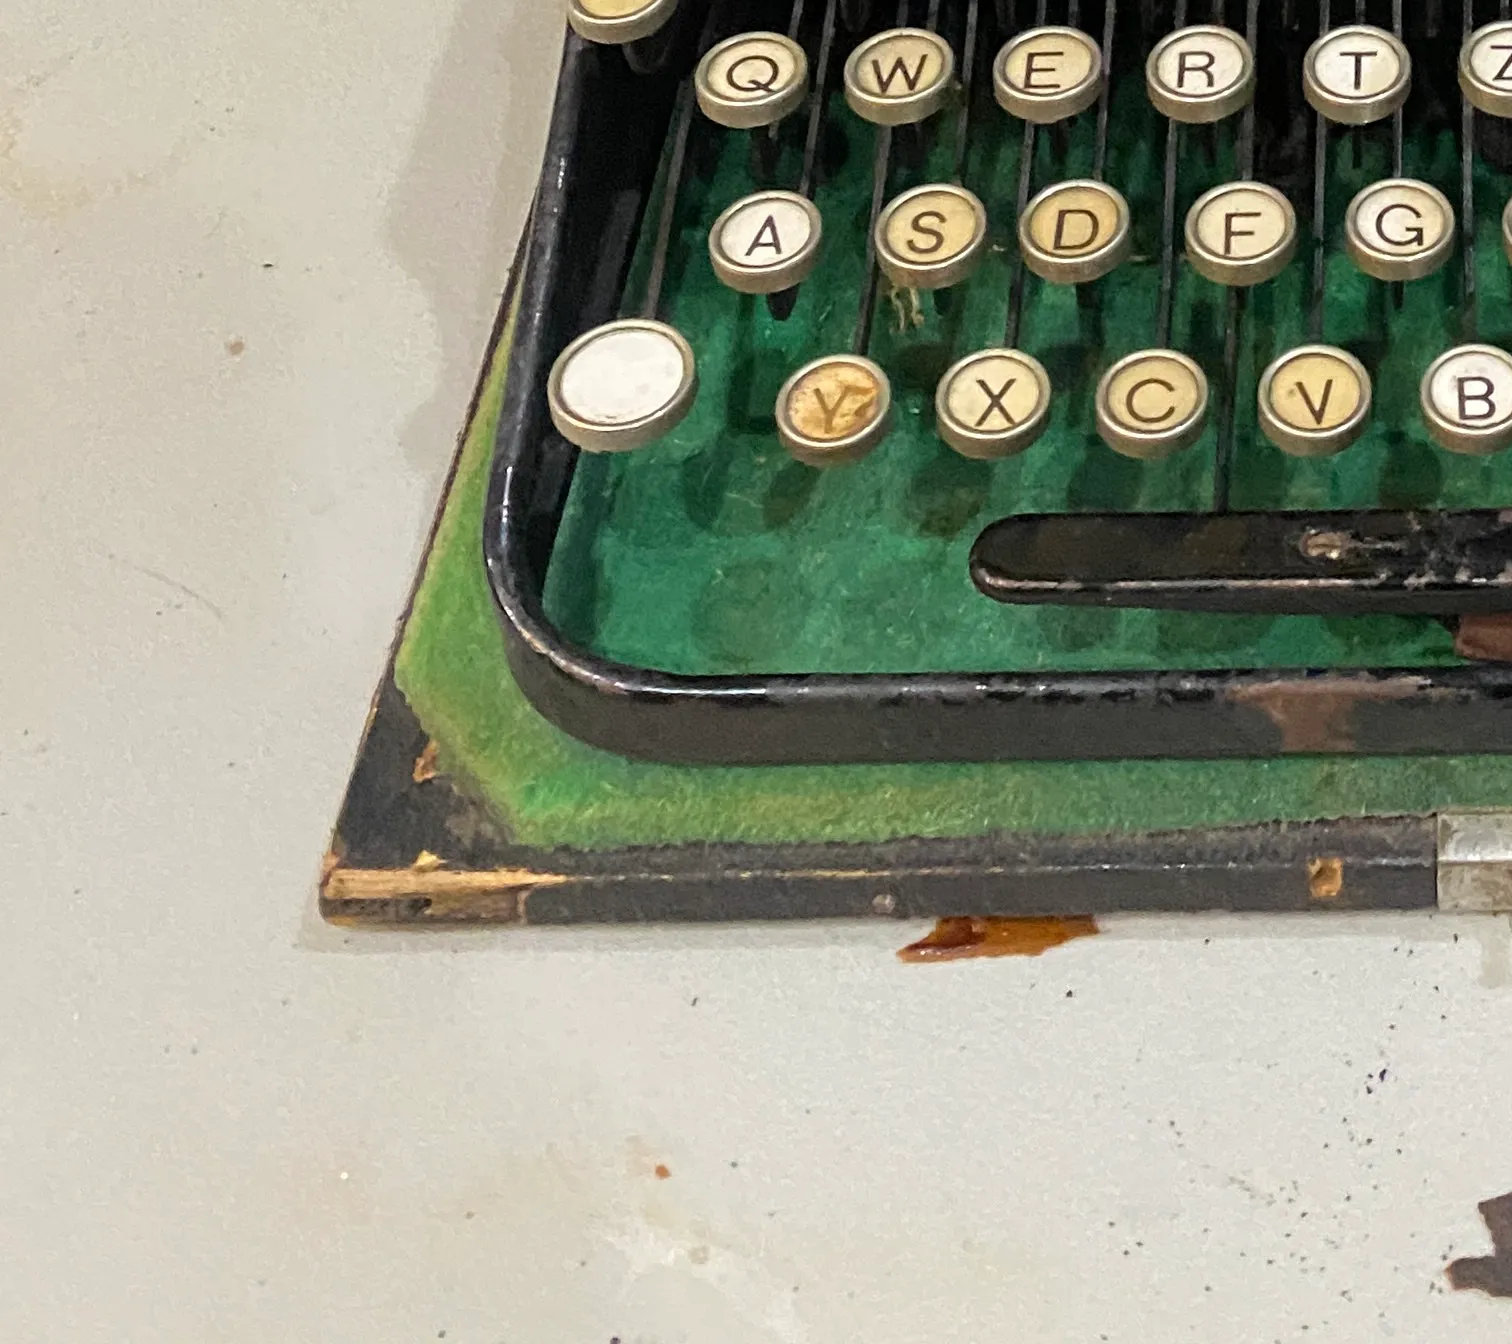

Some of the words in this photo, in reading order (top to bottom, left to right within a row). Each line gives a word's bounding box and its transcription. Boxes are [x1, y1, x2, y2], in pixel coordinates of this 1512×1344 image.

[726, 54, 780, 94] Q
[871, 53, 928, 93] W
[1023, 51, 1064, 90] E
[1176, 51, 1216, 88] R
[1340, 51, 1378, 91] T
[744, 214, 783, 257] A
[905, 210, 946, 255] S
[1053, 209, 1100, 251] D
[1223, 211, 1262, 256] F
[1374, 203, 1425, 248] G
[813, 387, 848, 434] Y
[974, 377, 1017, 428] X
[1124, 376, 1177, 424] C
[1295, 378, 1334, 426] V
[1456, 375, 1496, 421] B
